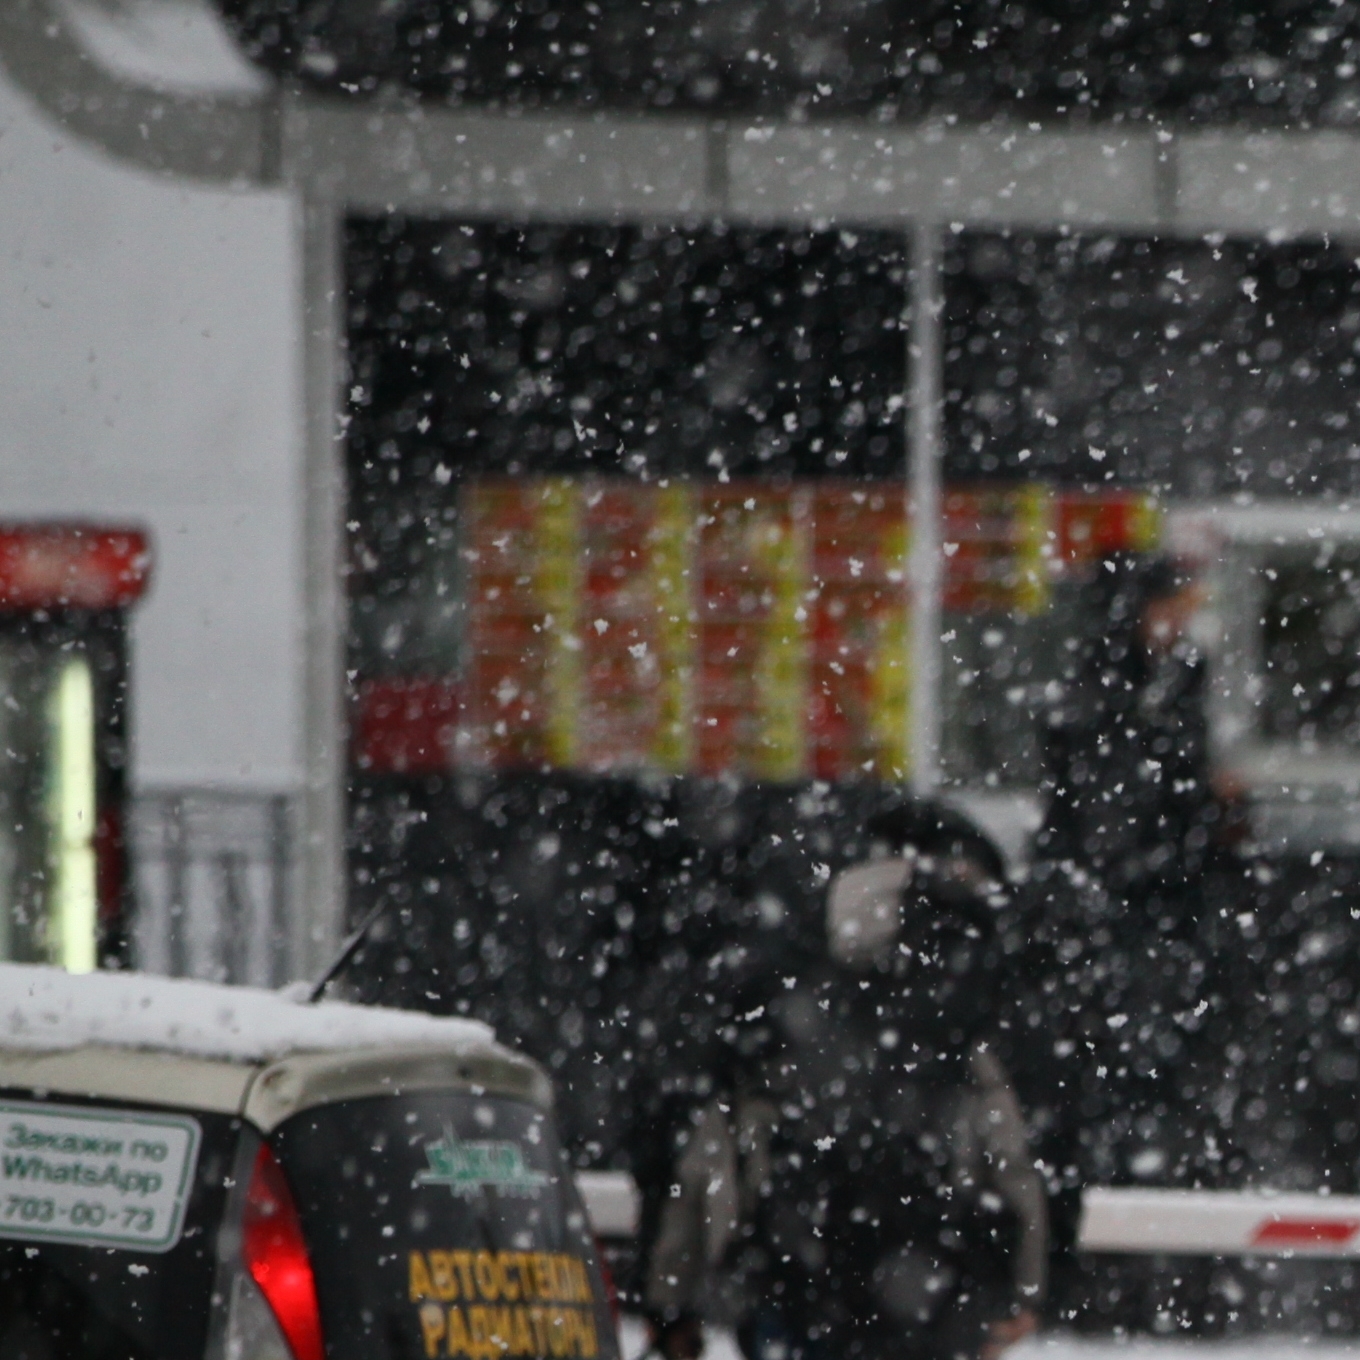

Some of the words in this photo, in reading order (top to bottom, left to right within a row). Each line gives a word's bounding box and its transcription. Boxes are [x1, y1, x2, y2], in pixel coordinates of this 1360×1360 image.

[5, 1122, 124, 1155] Закажи
[129, 1139, 169, 1163] по
[2, 1155, 163, 1197] WhatsApp
